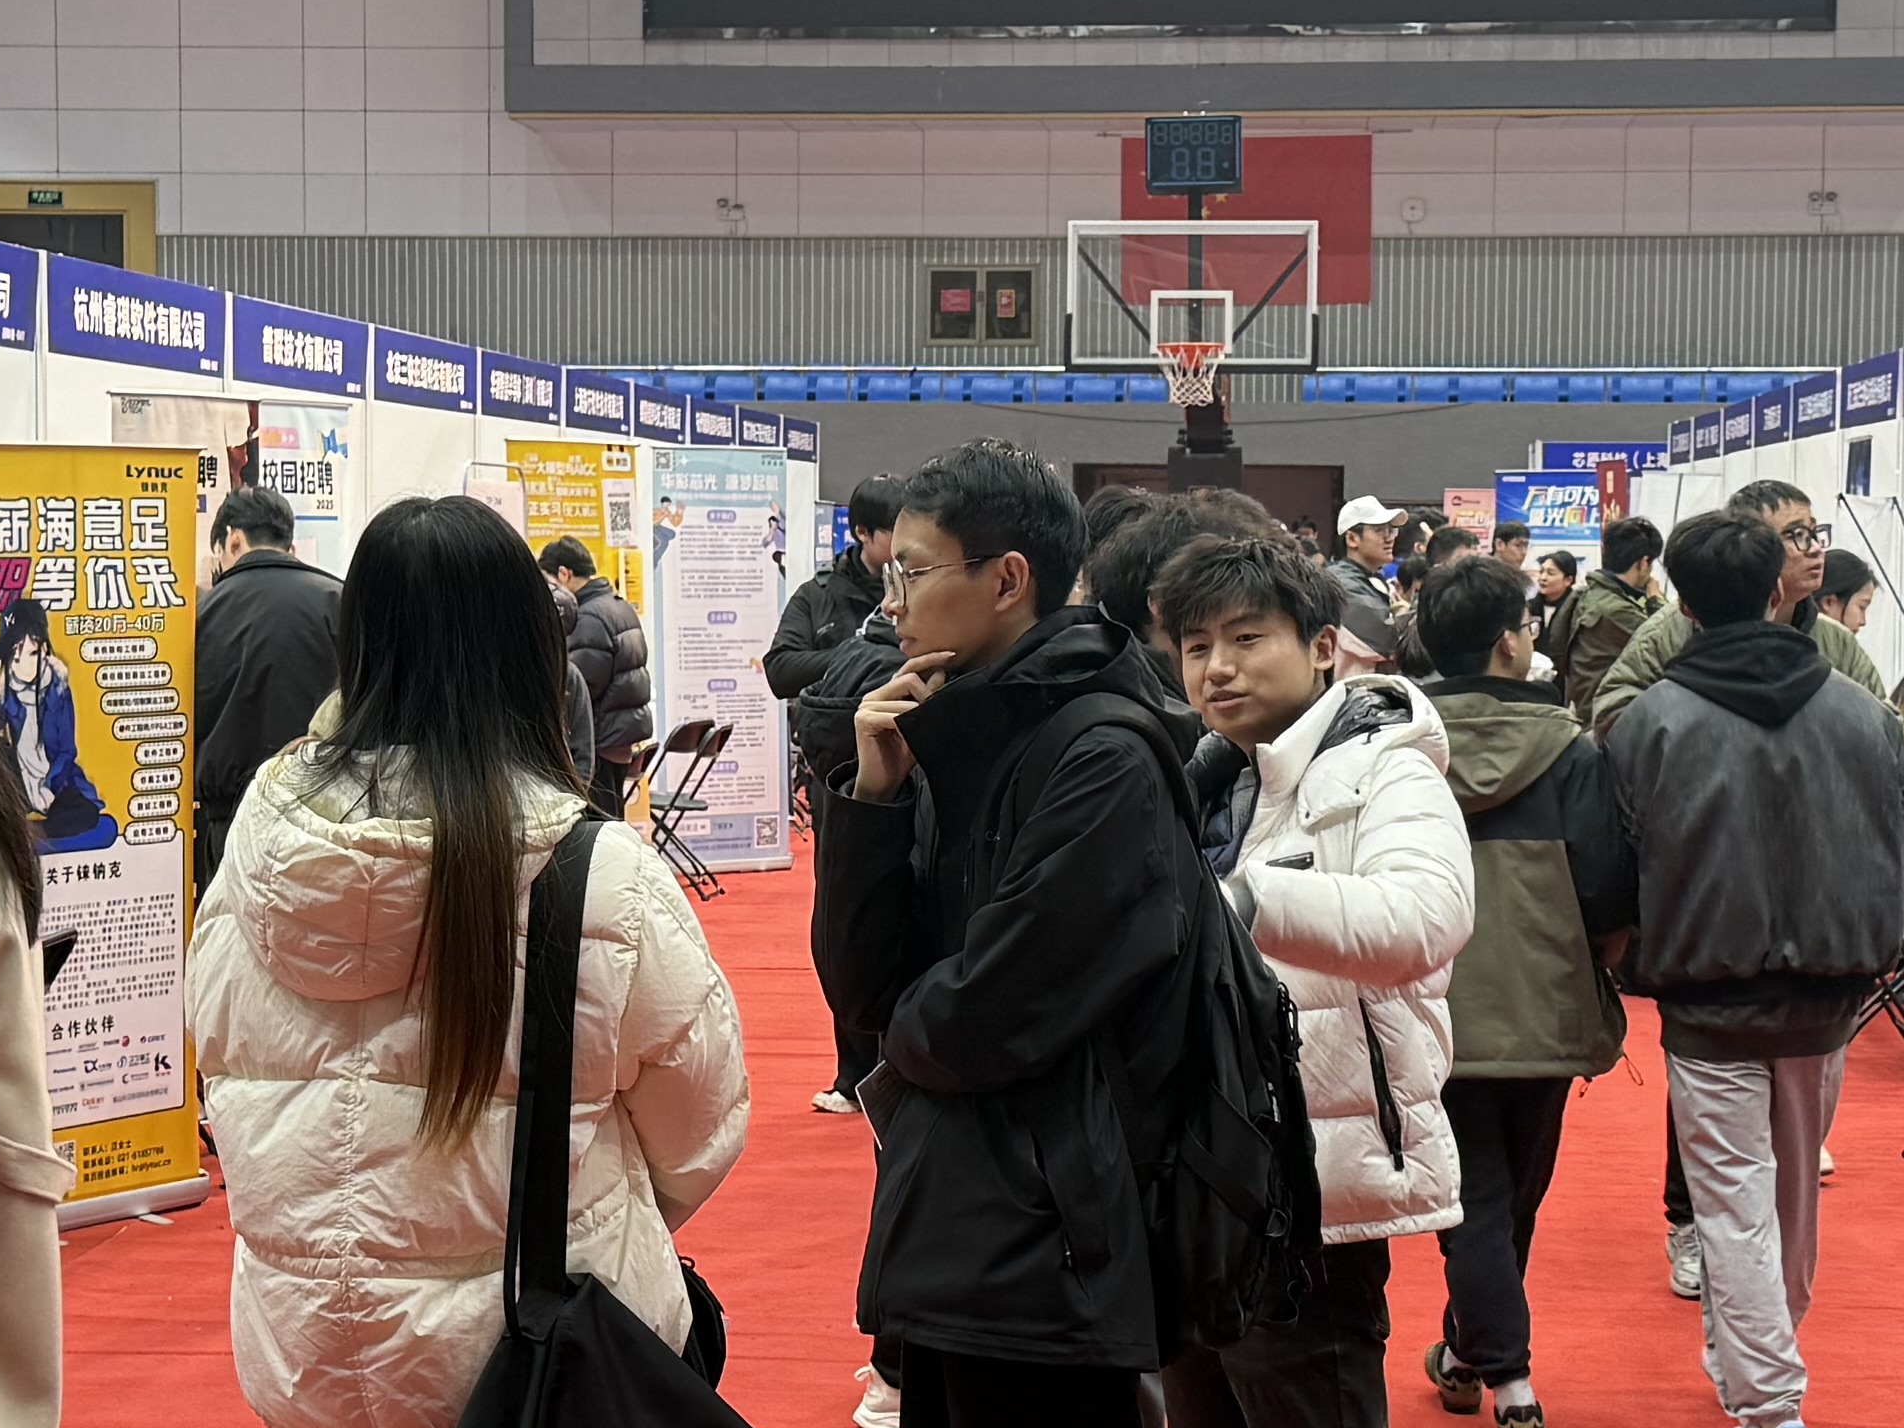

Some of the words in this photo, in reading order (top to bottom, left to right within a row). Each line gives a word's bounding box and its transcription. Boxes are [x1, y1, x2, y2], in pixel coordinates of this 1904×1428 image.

[262, 458, 334, 496] 校园招聘
[64, 613, 165, 636] 薪资20万-40万
[46, 860, 122, 886] 关于铼钠克
[51, 1014, 115, 1041] 合作伙伴
